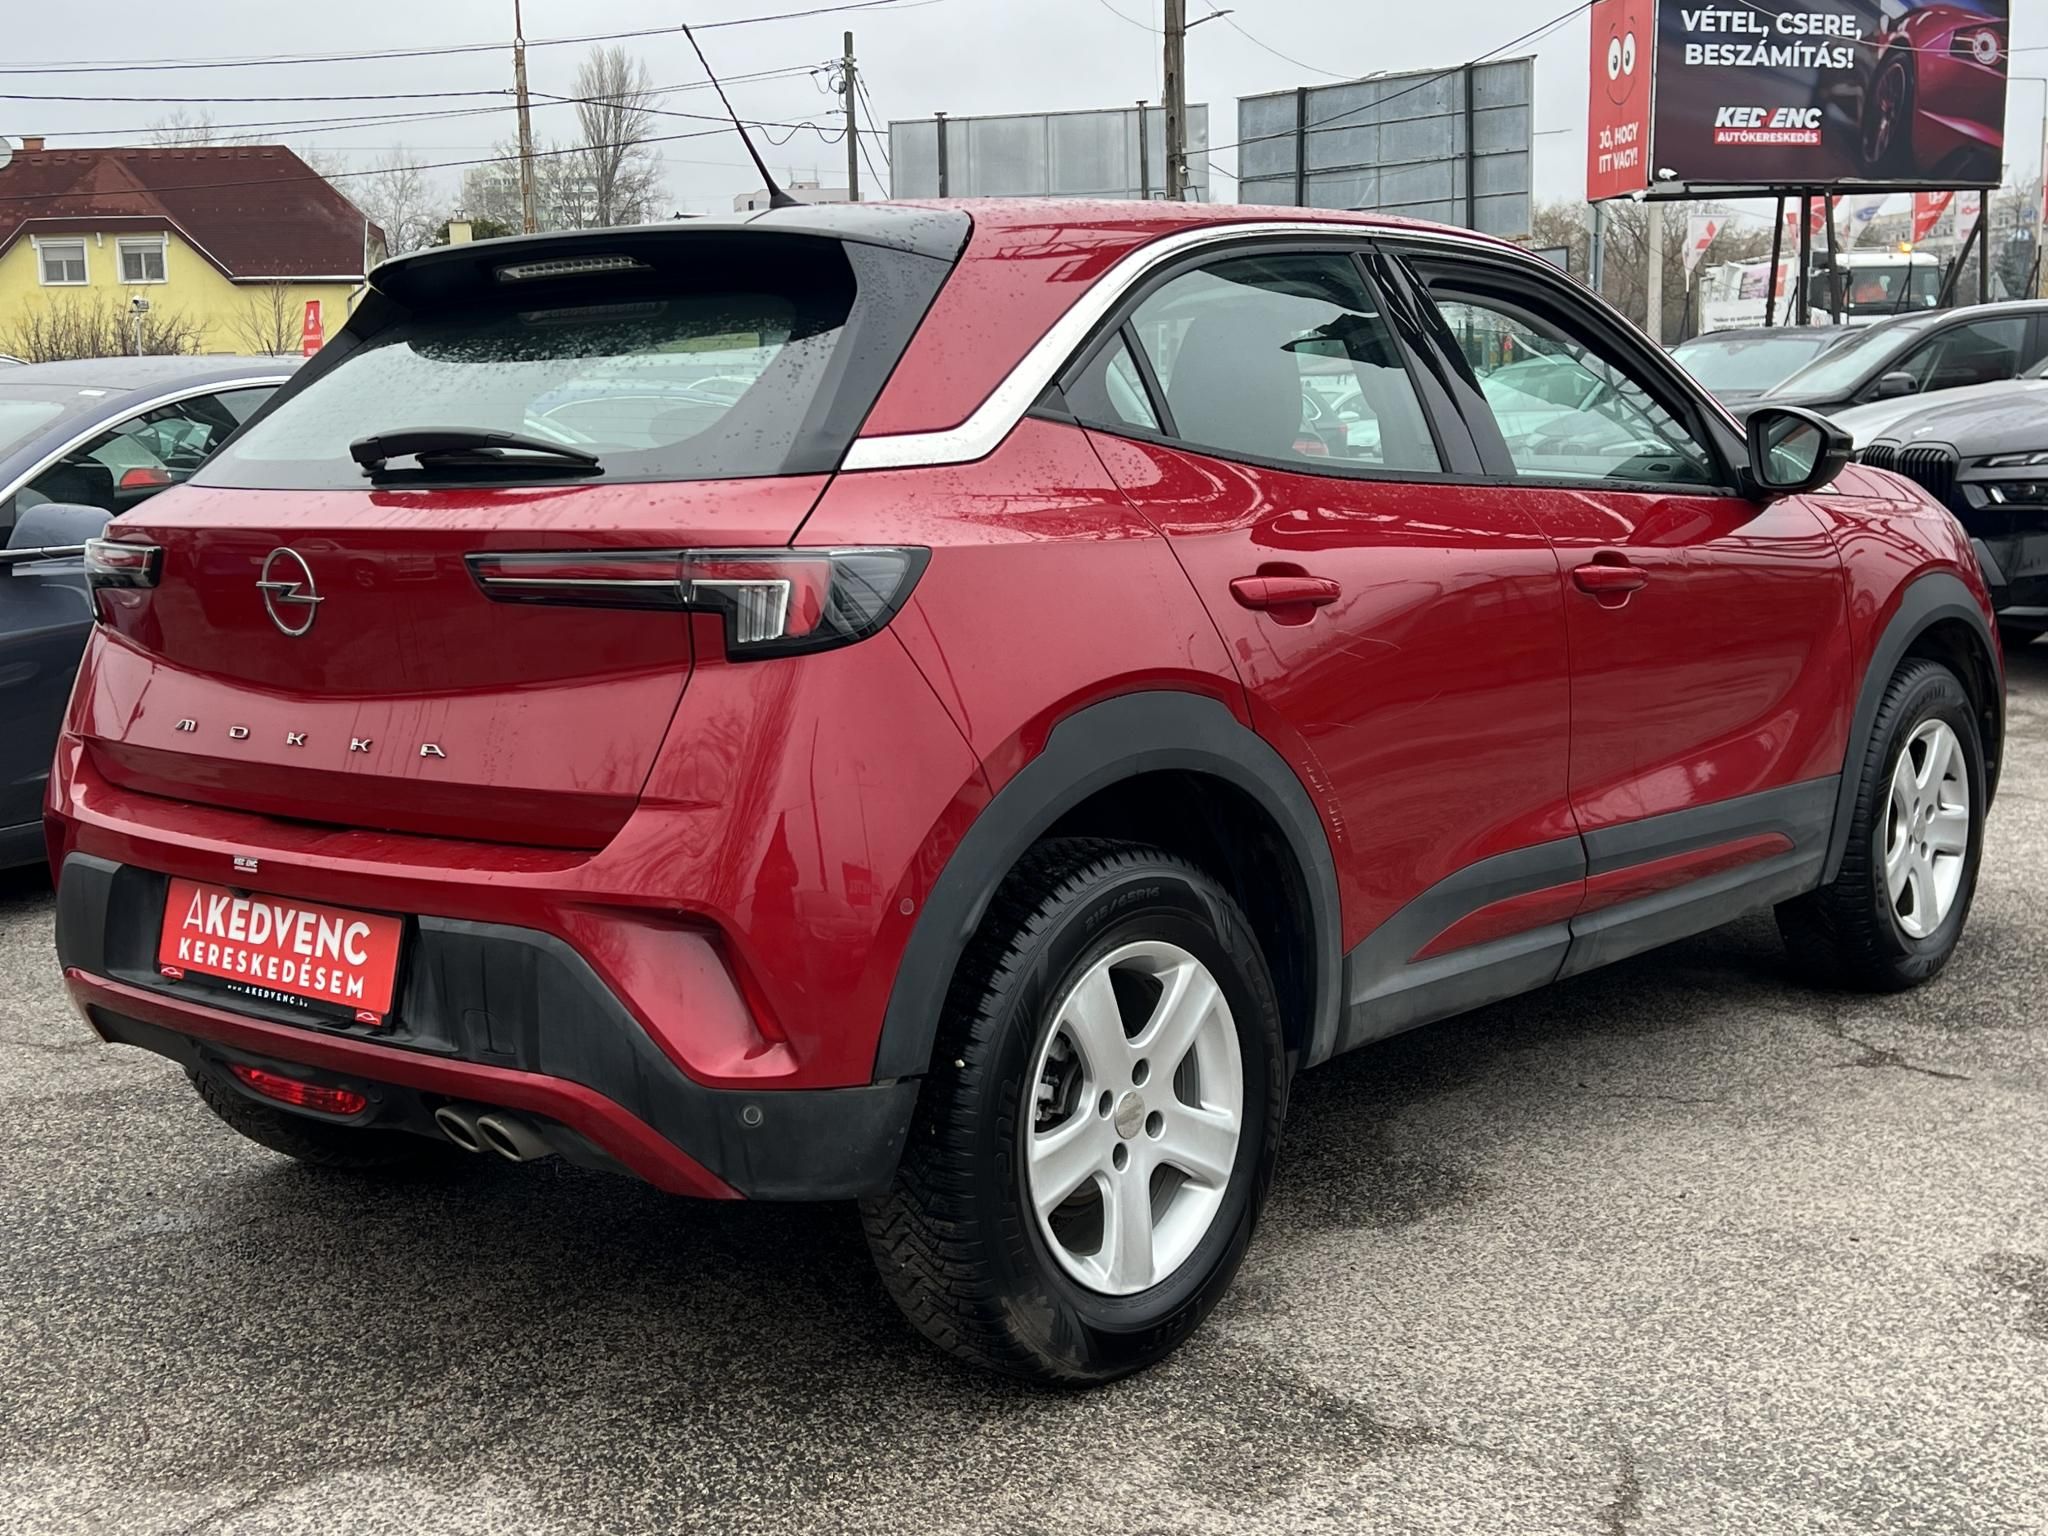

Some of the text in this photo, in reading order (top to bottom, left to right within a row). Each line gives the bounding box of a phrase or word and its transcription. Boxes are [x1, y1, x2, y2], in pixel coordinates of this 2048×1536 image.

[1681, 5, 1862, 41] VÉTEL, CSERE,
[1685, 40, 1855, 69] BESZÁMÍTÁS!
[1599, 121, 1639, 150] JÓ, HOGY
[1718, 130, 1819, 144] AUTÓKERESKEDÉS
[1599, 147, 1638, 174] ITT VAGY!
[175, 719, 446, 758] MOKKA
[178, 936, 365, 999] KERESKEDÉSEM
